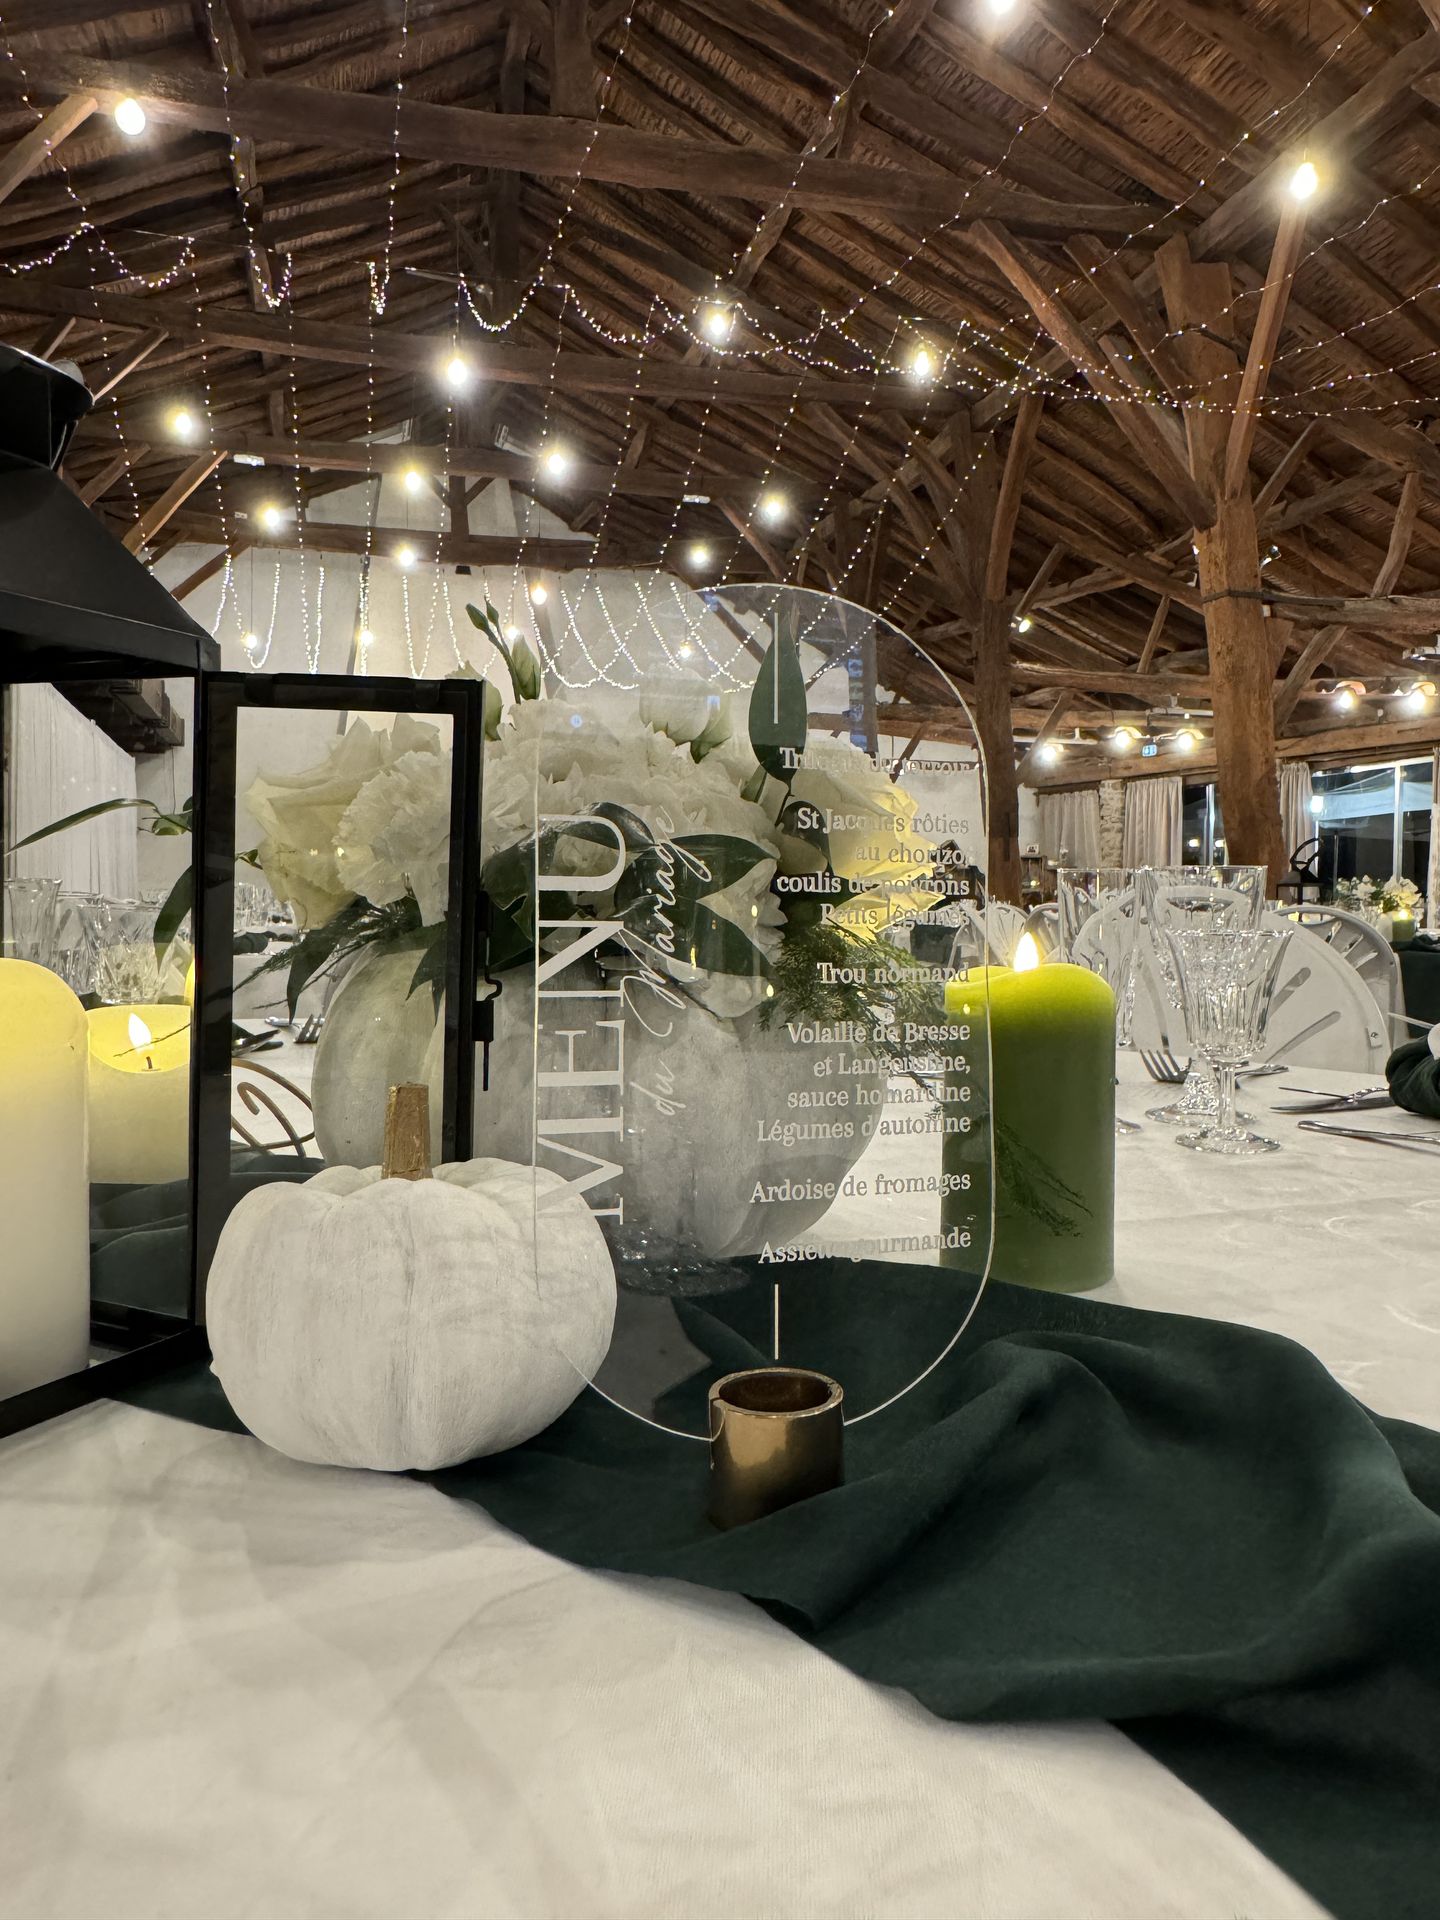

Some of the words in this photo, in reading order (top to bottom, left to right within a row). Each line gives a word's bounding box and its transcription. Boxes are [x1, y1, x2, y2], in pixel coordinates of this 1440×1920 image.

[797, 807, 818, 830] St
[821, 809, 905, 834] Jaces
[912, 813, 969, 834] rôties
[856, 844, 880, 861] au
[776, 872, 841, 894] coulis
[848, 873, 872, 893] de
[882, 873, 970, 900] poivrons
[618, 805, 712, 1038] Mariage
[819, 903, 878, 925] Petits
[816, 961, 866, 984] Trou
[874, 961, 970, 984] normand
[538, 813, 626, 1226] MENU
[786, 1021, 867, 1044] Volaille
[873, 1021, 900, 1043] de
[904, 1021, 971, 1044] Bresse
[813, 1056, 833, 1077] et
[629, 1058, 686, 1115] du
[787, 1089, 849, 1108] sauce
[757, 1119, 854, 1147] Légumes
[862, 1114, 971, 1137] dautomne
[749, 1178, 836, 1203] Ardoise
[843, 1175, 867, 1196] de
[875, 1173, 971, 1197] fromages
[758, 1240, 845, 1264] Assie
[849, 1226, 971, 1263] urmande
